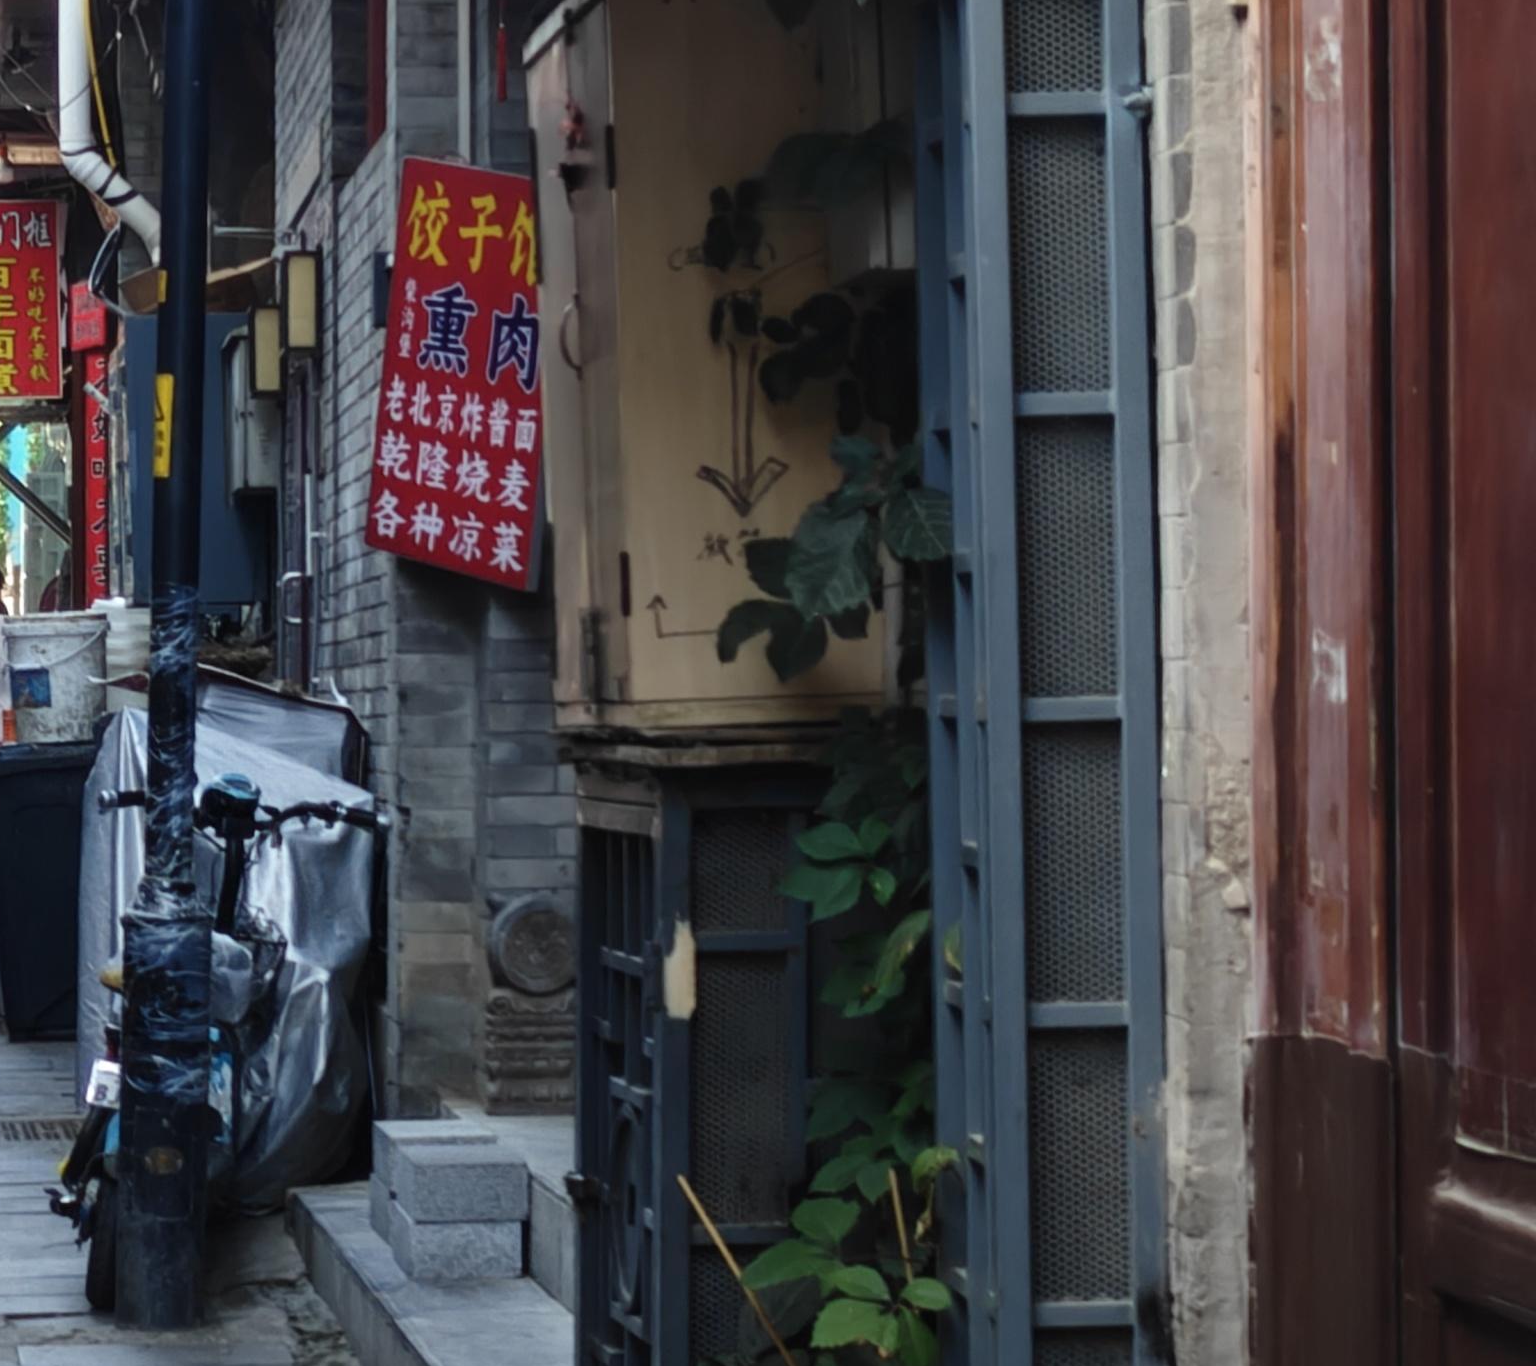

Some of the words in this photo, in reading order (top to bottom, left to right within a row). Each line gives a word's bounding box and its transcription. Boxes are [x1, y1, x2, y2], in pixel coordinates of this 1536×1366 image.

[27, 268, 50, 382] 不好吃不要钱
[417, 283, 539, 394] 熏肉
[385, 373, 537, 453] 老北京炸酱面
[376, 429, 530, 511] 乾隆烧麦
[372, 489, 523, 572] 各种凉菜
